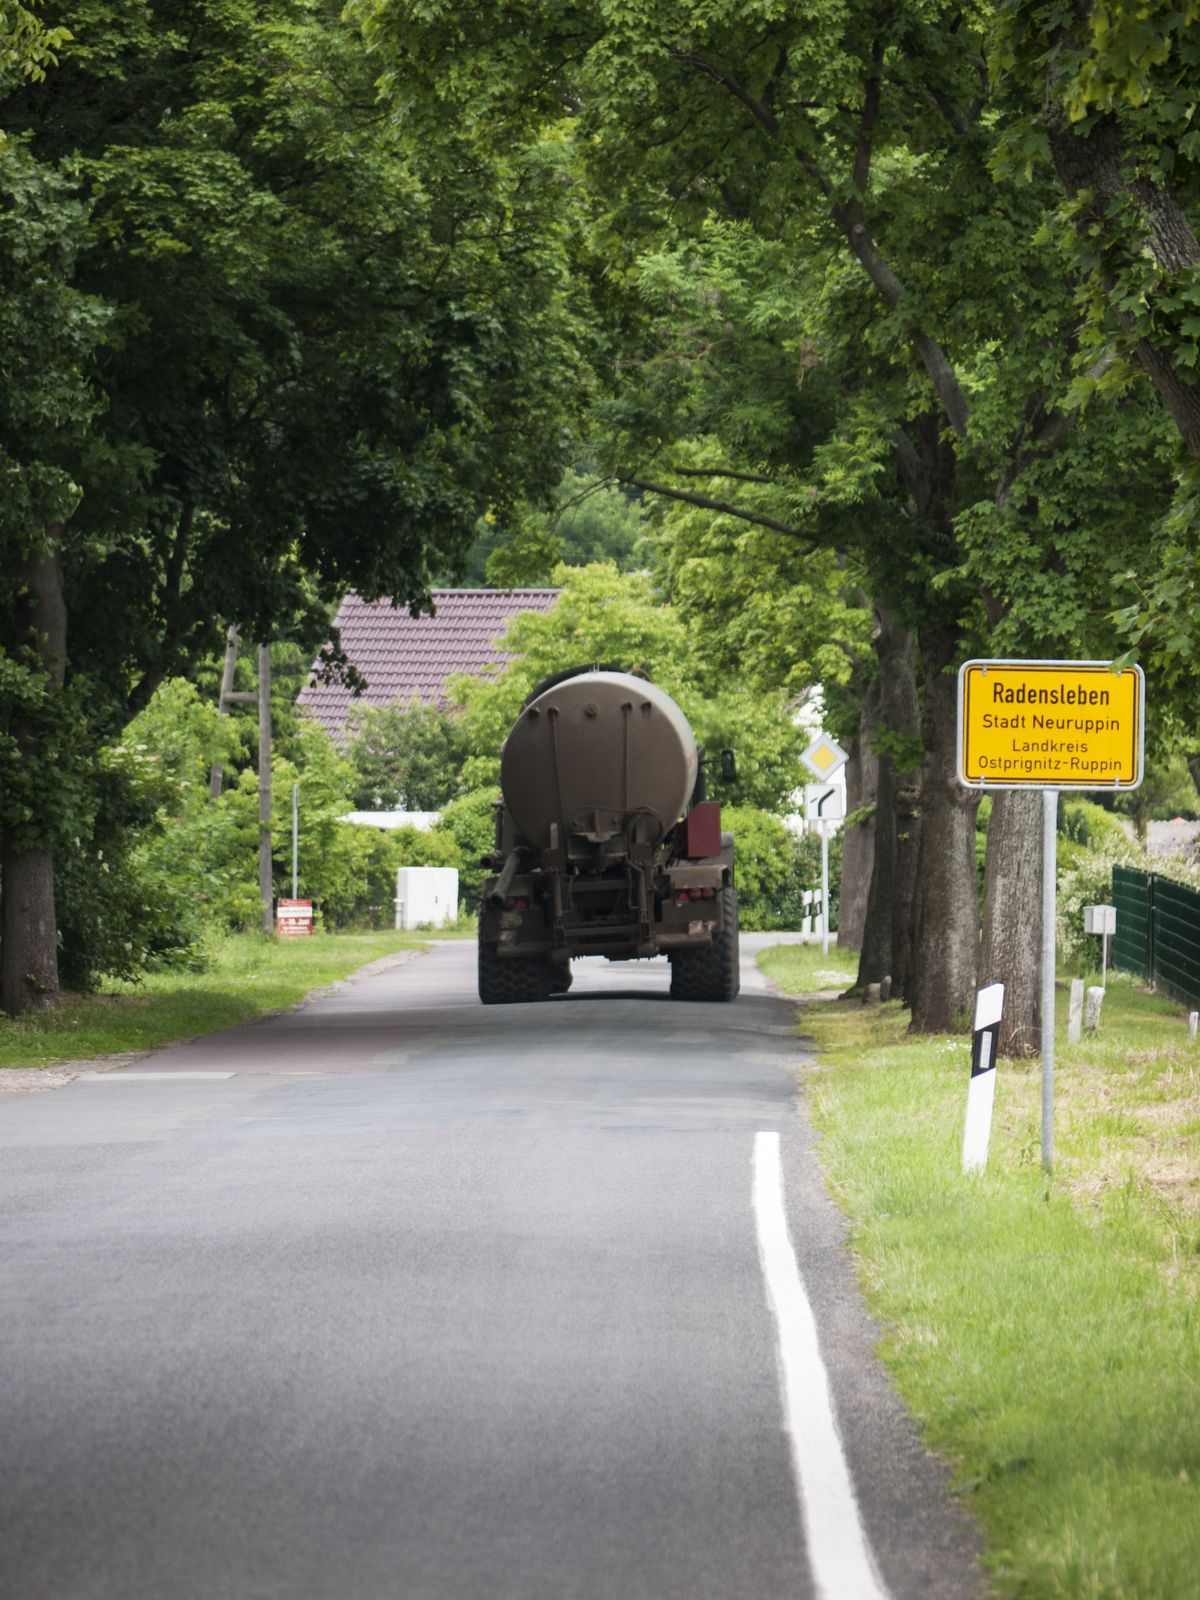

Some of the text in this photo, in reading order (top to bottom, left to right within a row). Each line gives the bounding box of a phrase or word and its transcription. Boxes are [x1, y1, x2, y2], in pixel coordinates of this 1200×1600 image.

[993, 682, 1110, 705] Radensleben
[983, 714, 1120, 734] Stadt Neuruppin
[1012, 739, 1088, 753] Landkreis
[978, 755, 1122, 773] Ostprignitz-Ruppin
